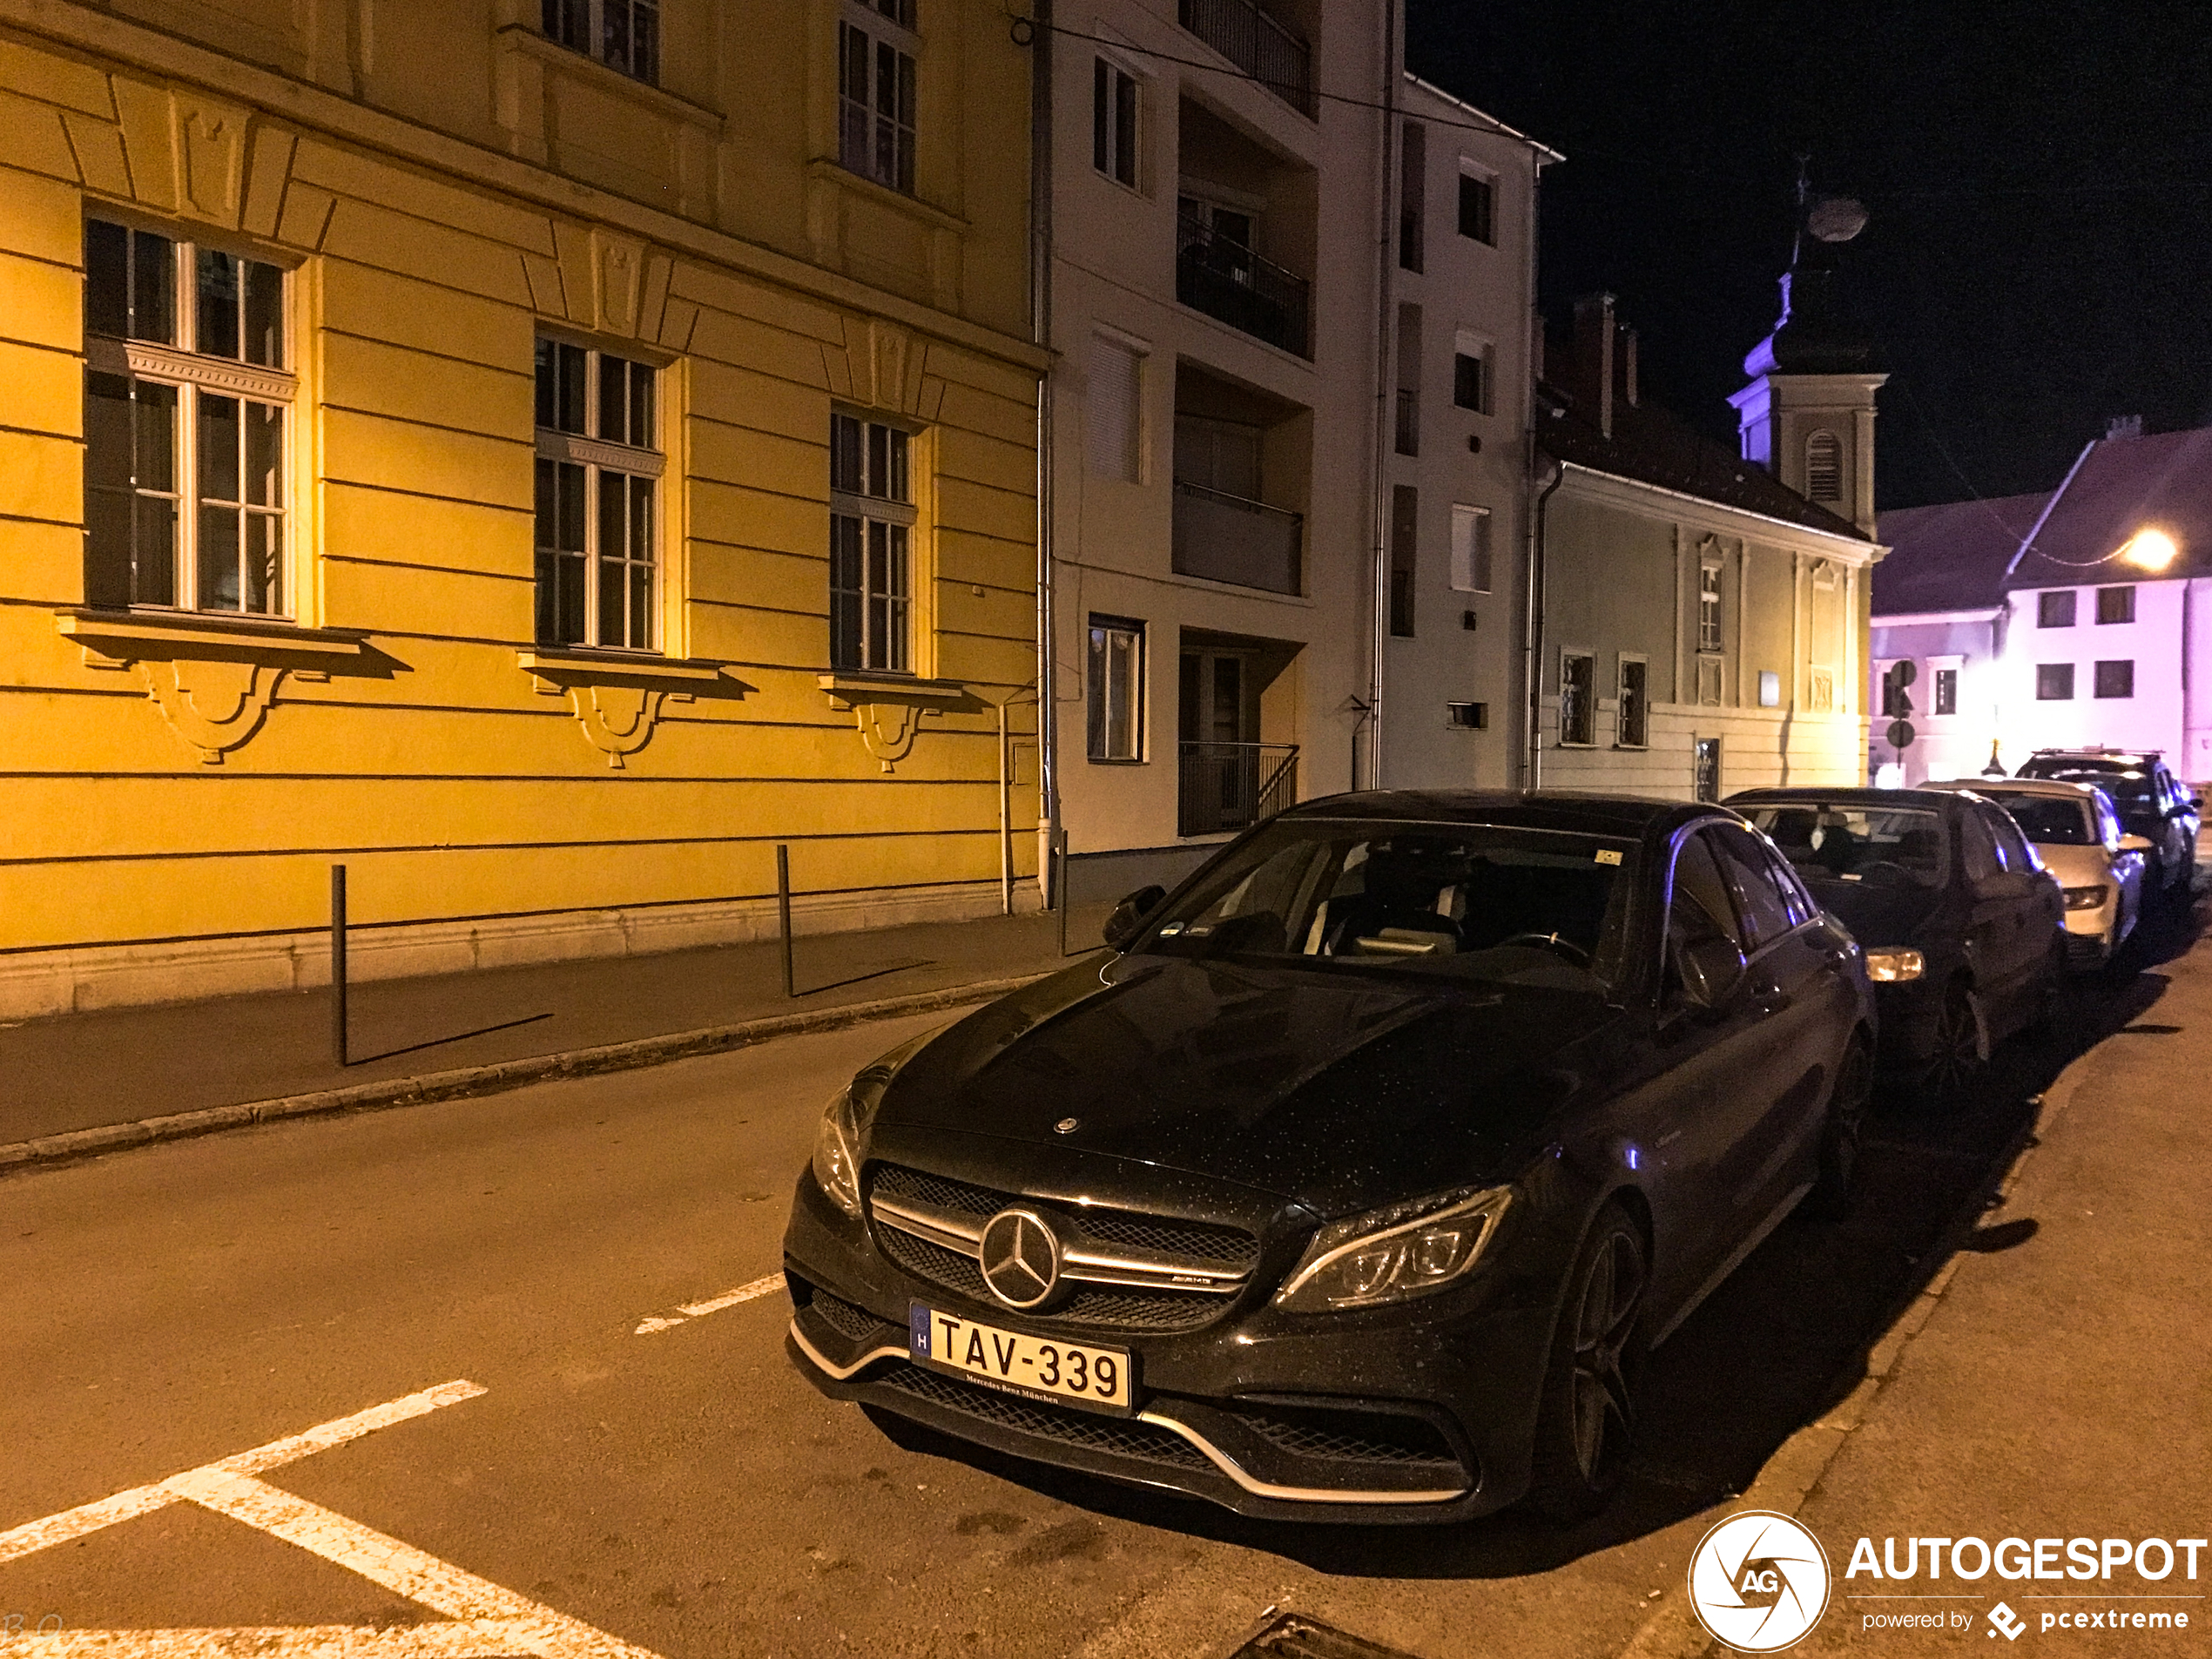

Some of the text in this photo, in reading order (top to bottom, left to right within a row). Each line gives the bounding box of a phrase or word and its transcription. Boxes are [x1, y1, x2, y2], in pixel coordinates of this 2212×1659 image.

[917, 1333, 927, 1349] H
[939, 1318, 1117, 1398] TAV-339
[966, 1373, 1059, 1404] Mercedes-Benz München
